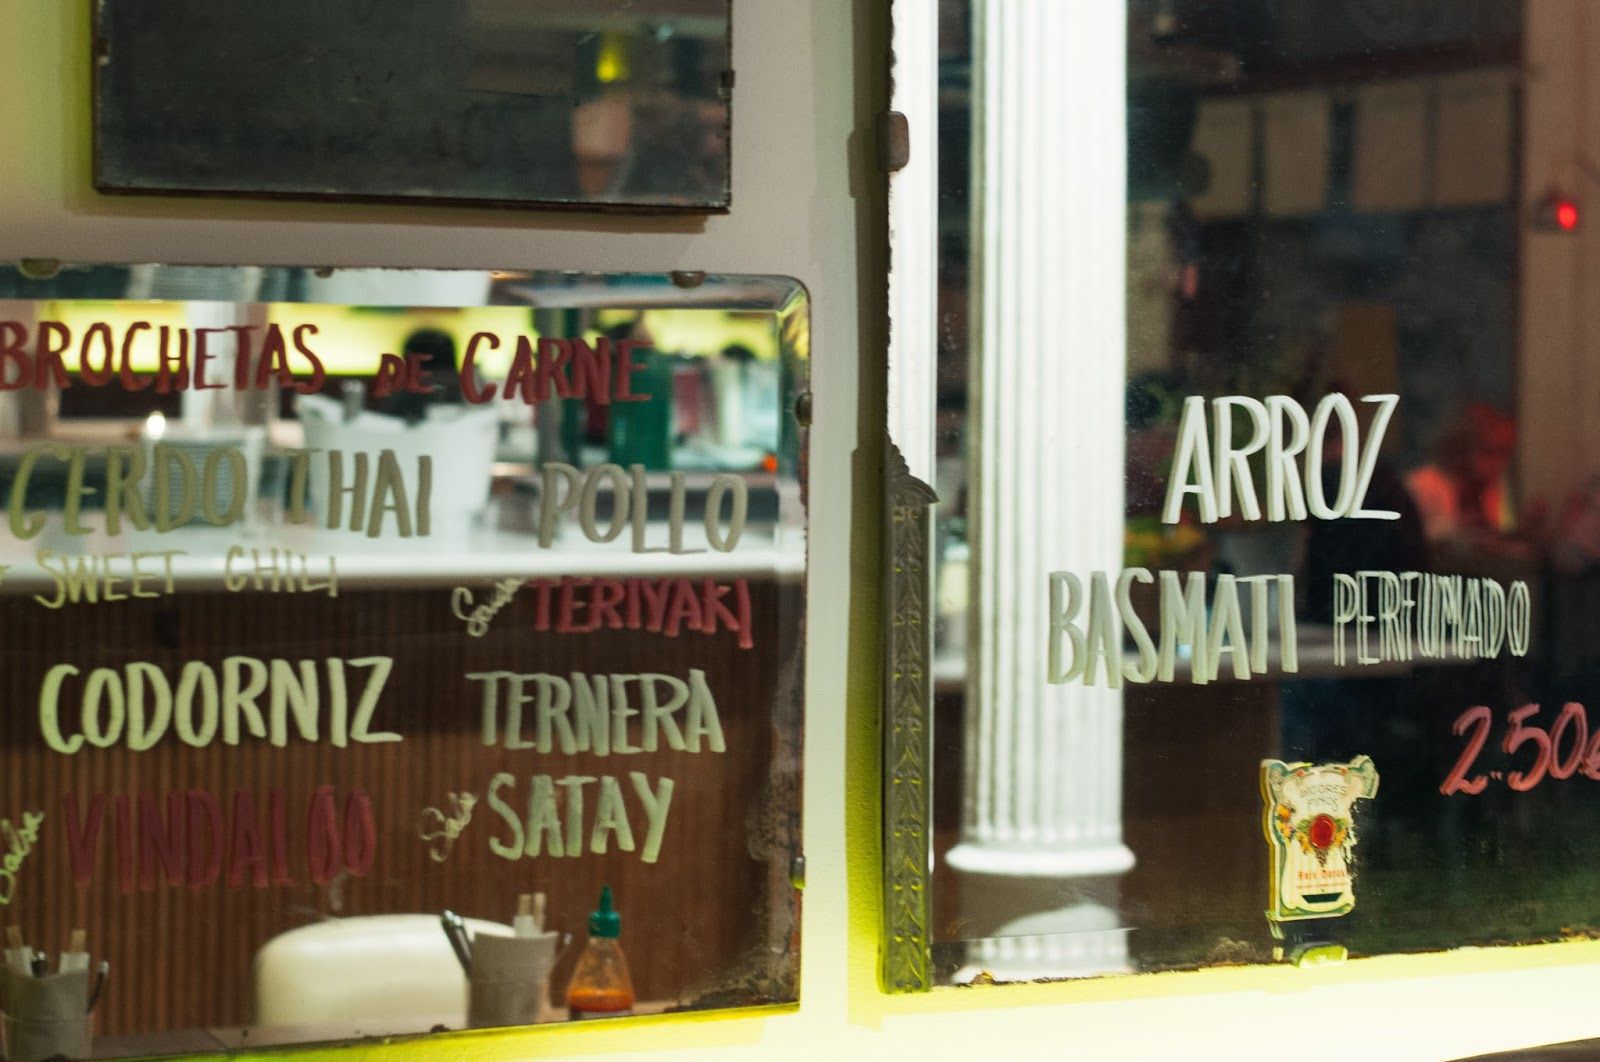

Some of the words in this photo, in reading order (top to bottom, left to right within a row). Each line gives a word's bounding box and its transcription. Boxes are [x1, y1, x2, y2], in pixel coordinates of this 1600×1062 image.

[0, 320, 326, 395] BROCHETAS
[374, 352, 434, 397] DE
[460, 331, 655, 405] CARNE
[9, 444, 248, 540] CERDO
[284, 447, 432, 538] THAI
[1161, 393, 1401, 524] ARROZ
[537, 462, 748, 555] POLLO
[34, 548, 188, 609] SWEET
[223, 545, 338, 597] CHILI
[526, 574, 754, 649] TERIYAKI
[1047, 567, 1298, 689] BASMATI
[1333, 570, 1532, 666] PERFUMADO
[39, 656, 403, 754] CODORNIZ
[464, 668, 726, 756] TERNERA
[63, 785, 376, 894] VINDALOO
[487, 771, 674, 863] SATAY
